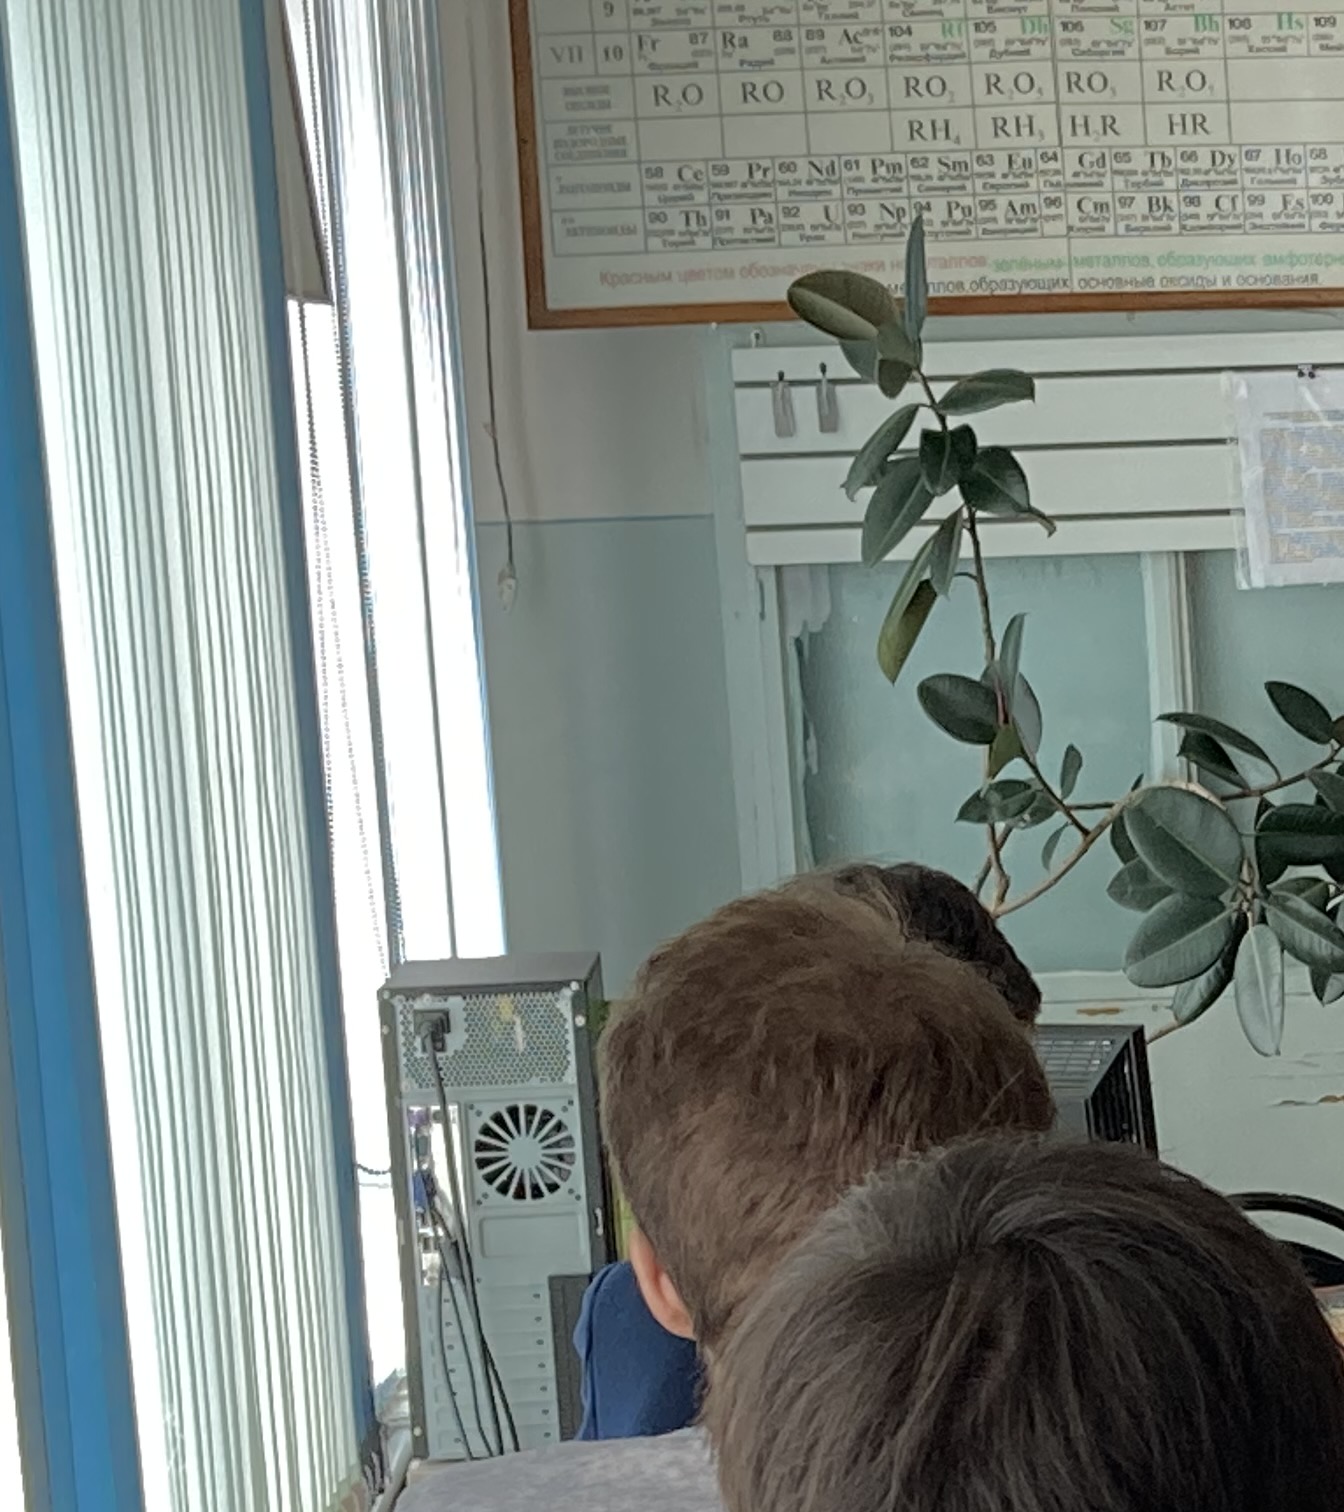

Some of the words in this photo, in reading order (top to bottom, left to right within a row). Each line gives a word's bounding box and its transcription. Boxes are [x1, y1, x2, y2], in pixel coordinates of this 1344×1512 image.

[604, 2, 615, 18] 9
[973, 20, 996, 34] 105
[1060, 19, 1085, 34] 106
[1109, 15, 1135, 36] Sg
[1144, 19, 1167, 33] 107
[1192, 13, 1220, 33] Bh
[1228, 18, 1253, 31] 108
[1275, 11, 1304, 31] Hs
[1314, 15, 1338, 29] 109
[721, 31, 749, 49] Ra
[773, 29, 793, 42] 88
[805, 28, 826, 42] 89
[888, 25, 913, 38] 104
[638, 34, 662, 52] Fr
[688, 32, 710, 45] 87
[550, 45, 584, 64] VII
[604, 46, 624, 63] 10
[741, 79, 785, 104] RO
[1168, 112, 1210, 136] HR
[842, 158, 861, 172] 61
[871, 157, 903, 175] Pm
[909, 156, 930, 169] 62
[936, 155, 969, 173] Sm
[976, 153, 995, 168] 63
[1040, 151, 1059, 165] 64
[1078, 151, 1107, 170] Gd
[1113, 150, 1132, 164] 65
[1210, 149, 1237, 169] Dy
[1244, 148, 1262, 161] 67
[1274, 148, 1302, 167] Ho
[712, 164, 730, 177] 59
[747, 162, 772, 180] Pr
[778, 160, 798, 174] 60
[808, 159, 836, 177] Nd
[912, 200, 933, 213] 94
[978, 198, 998, 212] 95
[1005, 198, 1037, 216] Am
[1042, 196, 1063, 209] 96
[1077, 196, 1111, 214] Cm
[1118, 196, 1136, 209] 97
[1146, 195, 1174, 214] Bk
[1246, 194, 1265, 207] 99
[1309, 192, 1335, 205] 100
[648, 211, 668, 224] 90
[679, 209, 707, 228] Th
[715, 209, 730, 222] 91
[750, 207, 774, 226] Pa
[781, 206, 801, 219] 92
[823, 204, 839, 223] U
[846, 202, 866, 216] 93
[880, 202, 907, 221] Np
[1077, 276, 1155, 290] основные
[1160, 275, 1218, 289] оксиды
[1222, 274, 1232, 286] и
